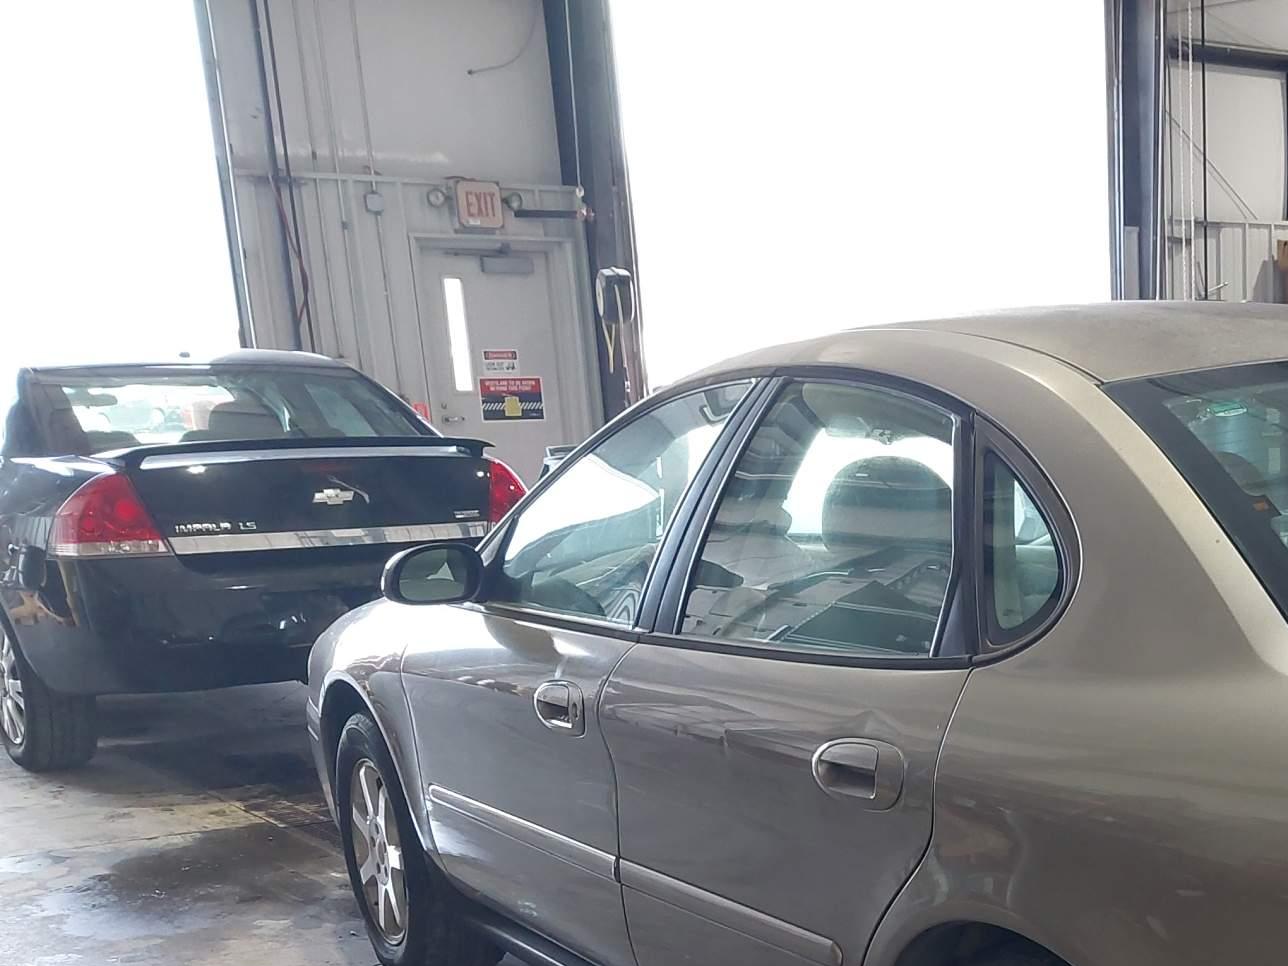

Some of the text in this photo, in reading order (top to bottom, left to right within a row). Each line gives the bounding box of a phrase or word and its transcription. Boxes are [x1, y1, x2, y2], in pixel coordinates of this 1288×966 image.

[466, 191, 496, 217] EXIT
[175, 521, 257, 533] IMPALA LS
